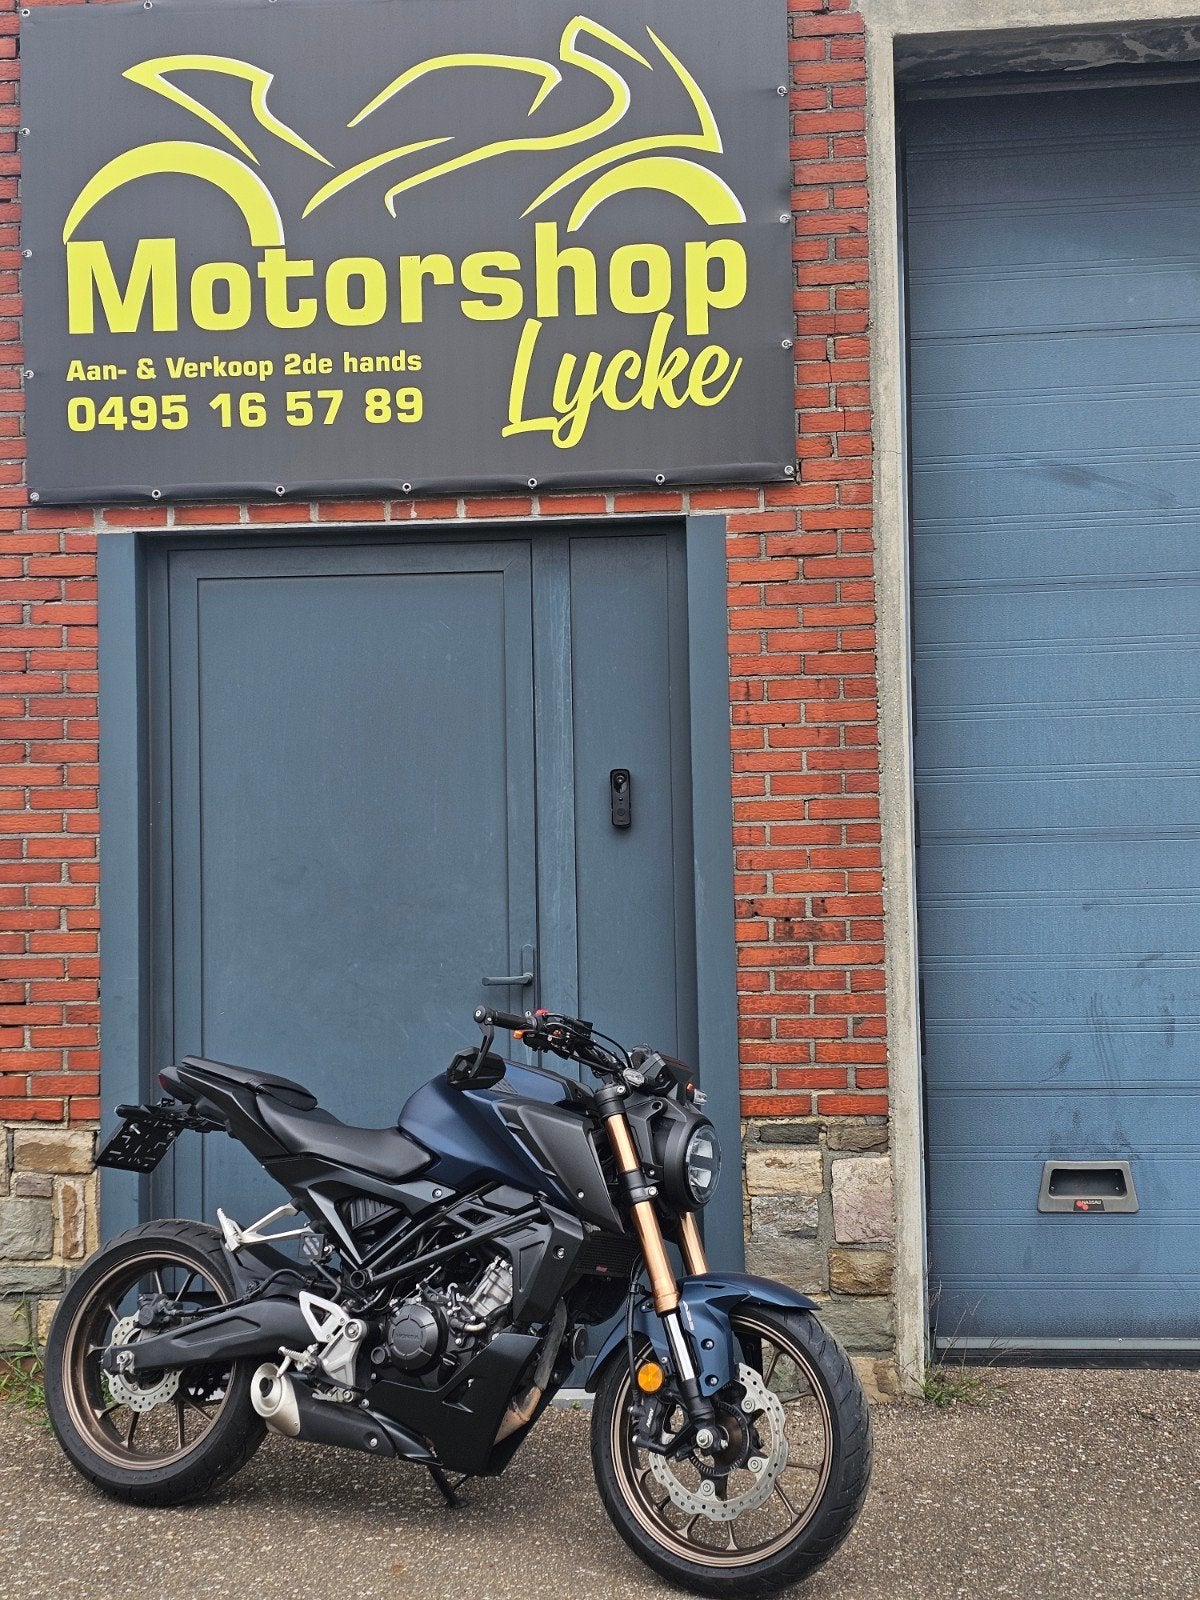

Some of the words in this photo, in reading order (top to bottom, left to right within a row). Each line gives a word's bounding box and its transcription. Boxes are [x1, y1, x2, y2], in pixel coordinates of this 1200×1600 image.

[66, 222, 749, 336] Motorshop
[66, 361, 128, 381] Aan-
[137, 359, 155, 379] &
[165, 357, 274, 381] Verkoop
[285, 354, 332, 375] 2de
[343, 350, 422, 373] hands
[502, 312, 742, 448] Lycke
[67, 394, 190, 432] 0495
[210, 392, 268, 428] 16
[285, 389, 344, 427] 57
[364, 387, 424, 424] 89
